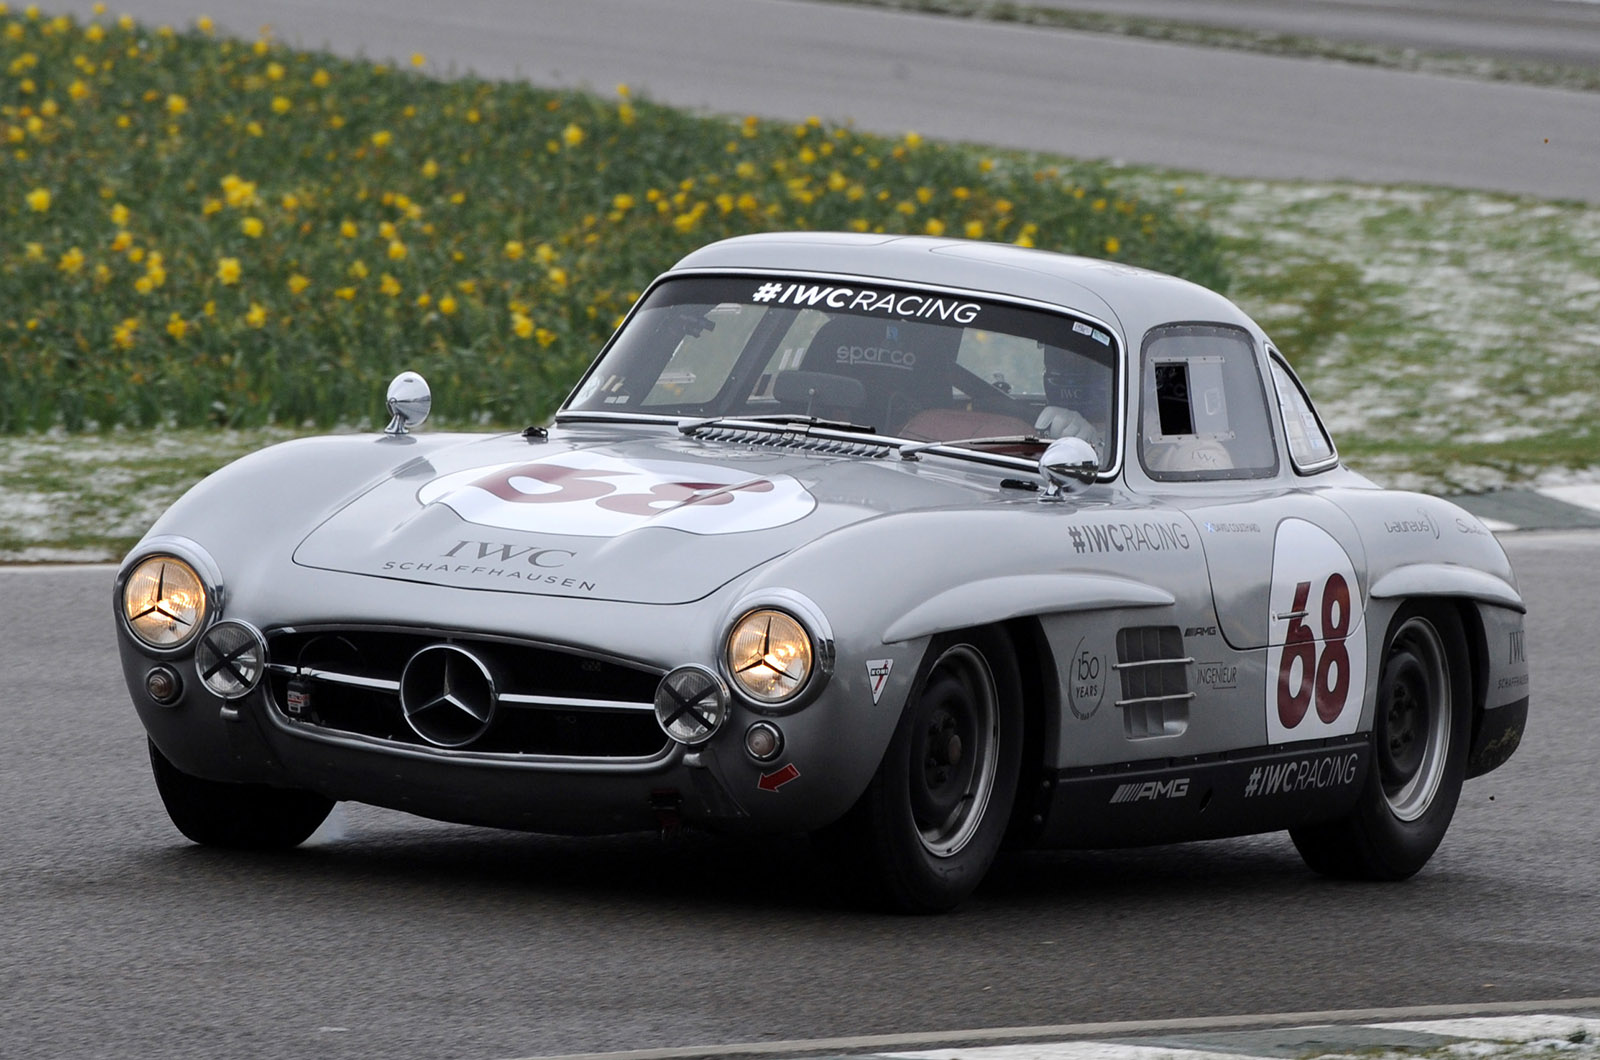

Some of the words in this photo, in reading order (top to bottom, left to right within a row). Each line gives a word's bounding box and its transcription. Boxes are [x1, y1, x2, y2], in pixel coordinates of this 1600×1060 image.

[752, 282, 981, 323] #IWCRACING
[836, 345, 916, 366] sparco
[1068, 523, 1190, 553] #IWCRACING
[440, 540, 577, 569] IWC
[382, 561, 597, 592] SCHAFFHAUSEN
[1194, 626, 1217, 637] AMG
[1277, 572, 1351, 729] 68
[1078, 651, 1100, 680] 150
[1197, 666, 1237, 684] INGENIEUR
[1076, 685, 1098, 698] YEARS
[1135, 778, 1190, 800] AMG
[1244, 753, 1359, 798] #IWCRACING
